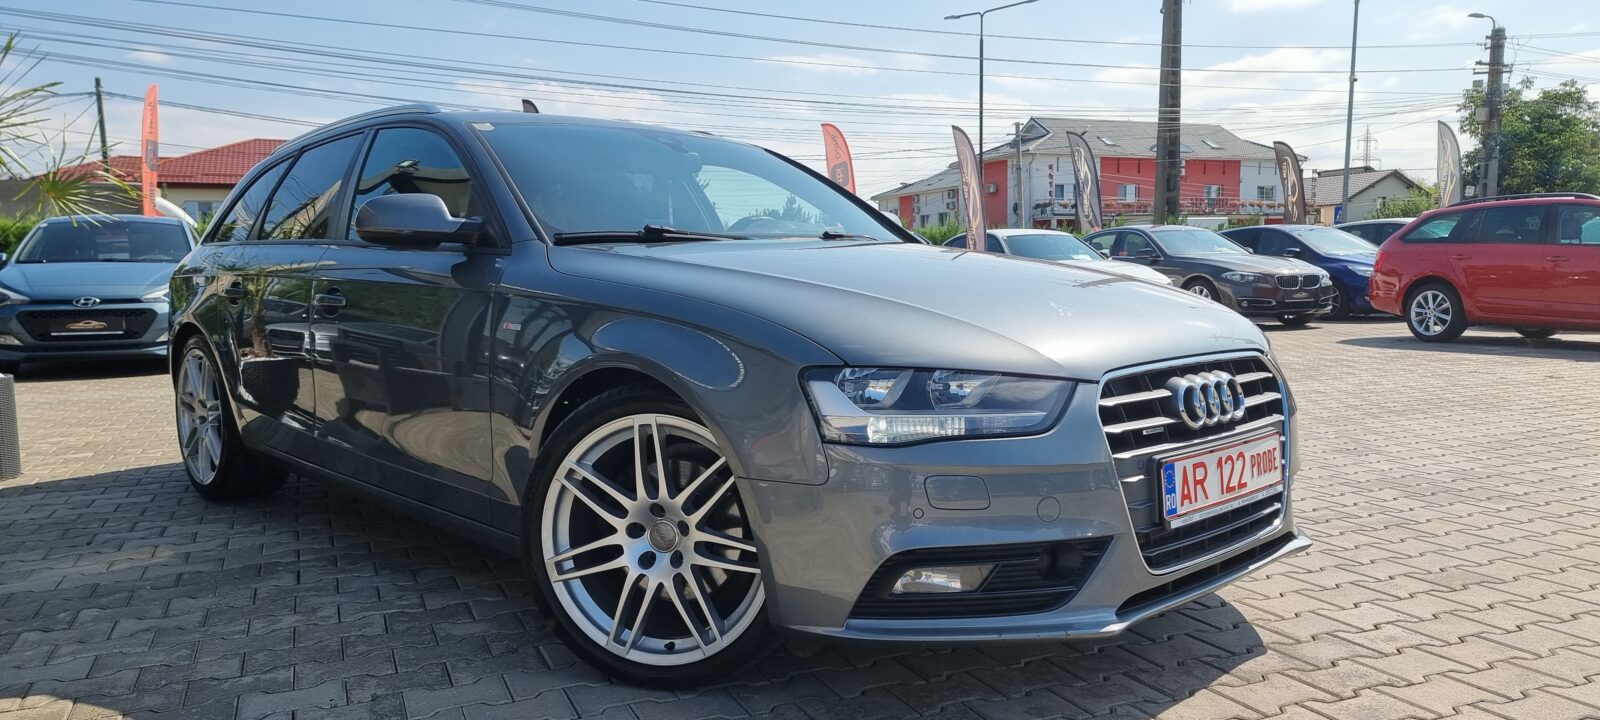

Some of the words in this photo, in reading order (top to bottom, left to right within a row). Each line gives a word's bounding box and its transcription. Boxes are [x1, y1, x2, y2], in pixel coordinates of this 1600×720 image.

[1181, 462, 1209, 507] AR
[1217, 452, 1248, 495] 122
[1251, 447, 1278, 479] PROBE
[1167, 494, 1177, 511] RO
